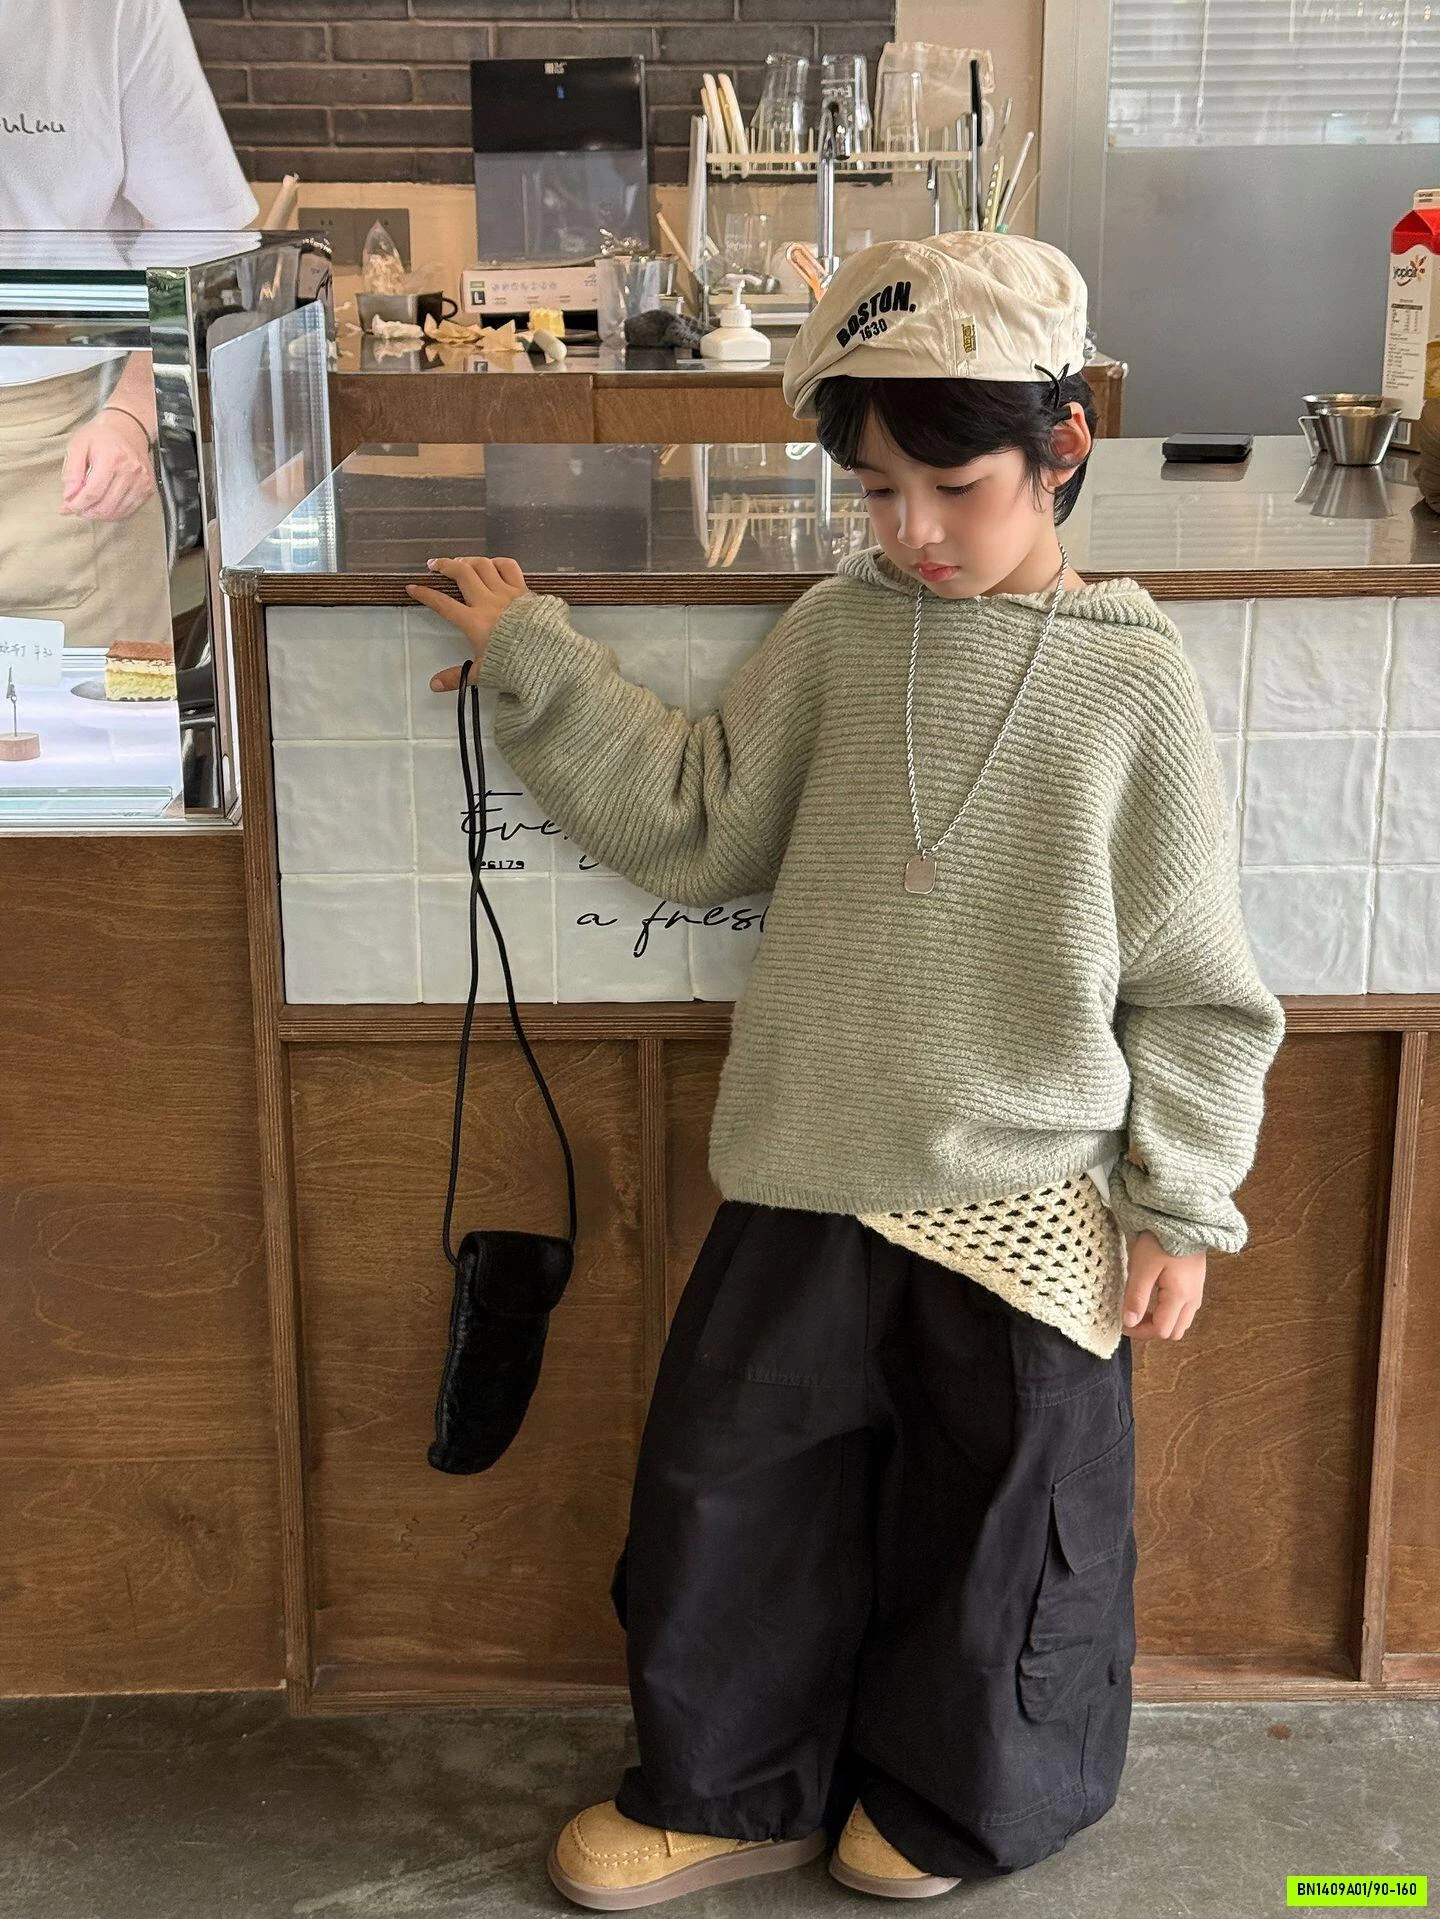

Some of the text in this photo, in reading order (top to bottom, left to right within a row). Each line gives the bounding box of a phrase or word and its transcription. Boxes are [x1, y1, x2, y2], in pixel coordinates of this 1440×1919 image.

[836, 281, 917, 348] BOSTON.
[859, 318, 888, 342] 1630
[576, 911, 618, 926] a
